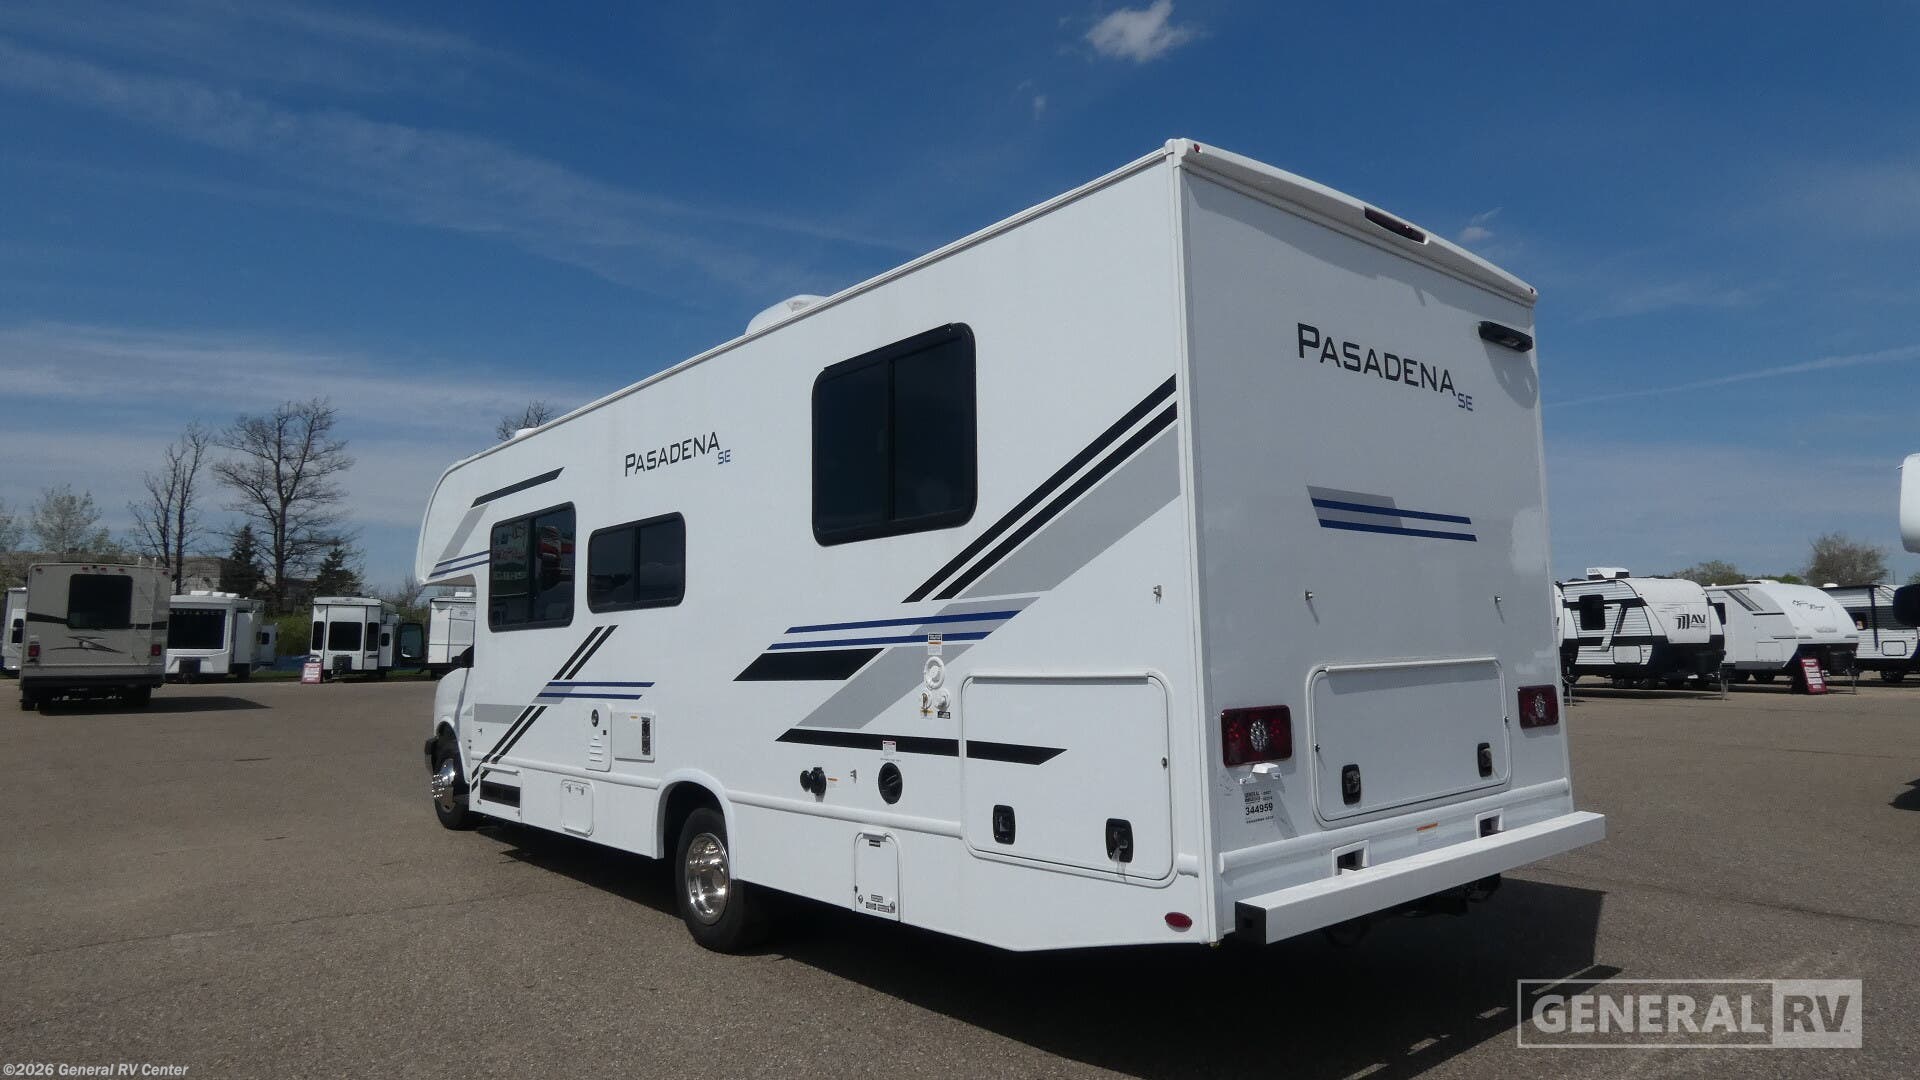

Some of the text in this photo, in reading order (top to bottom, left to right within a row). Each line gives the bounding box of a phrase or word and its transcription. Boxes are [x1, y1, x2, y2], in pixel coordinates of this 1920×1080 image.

[1297, 322, 1474, 411] PASADENA SE
[624, 431, 731, 477] PASADENA SE
[1245, 802, 1273, 815] 344959
